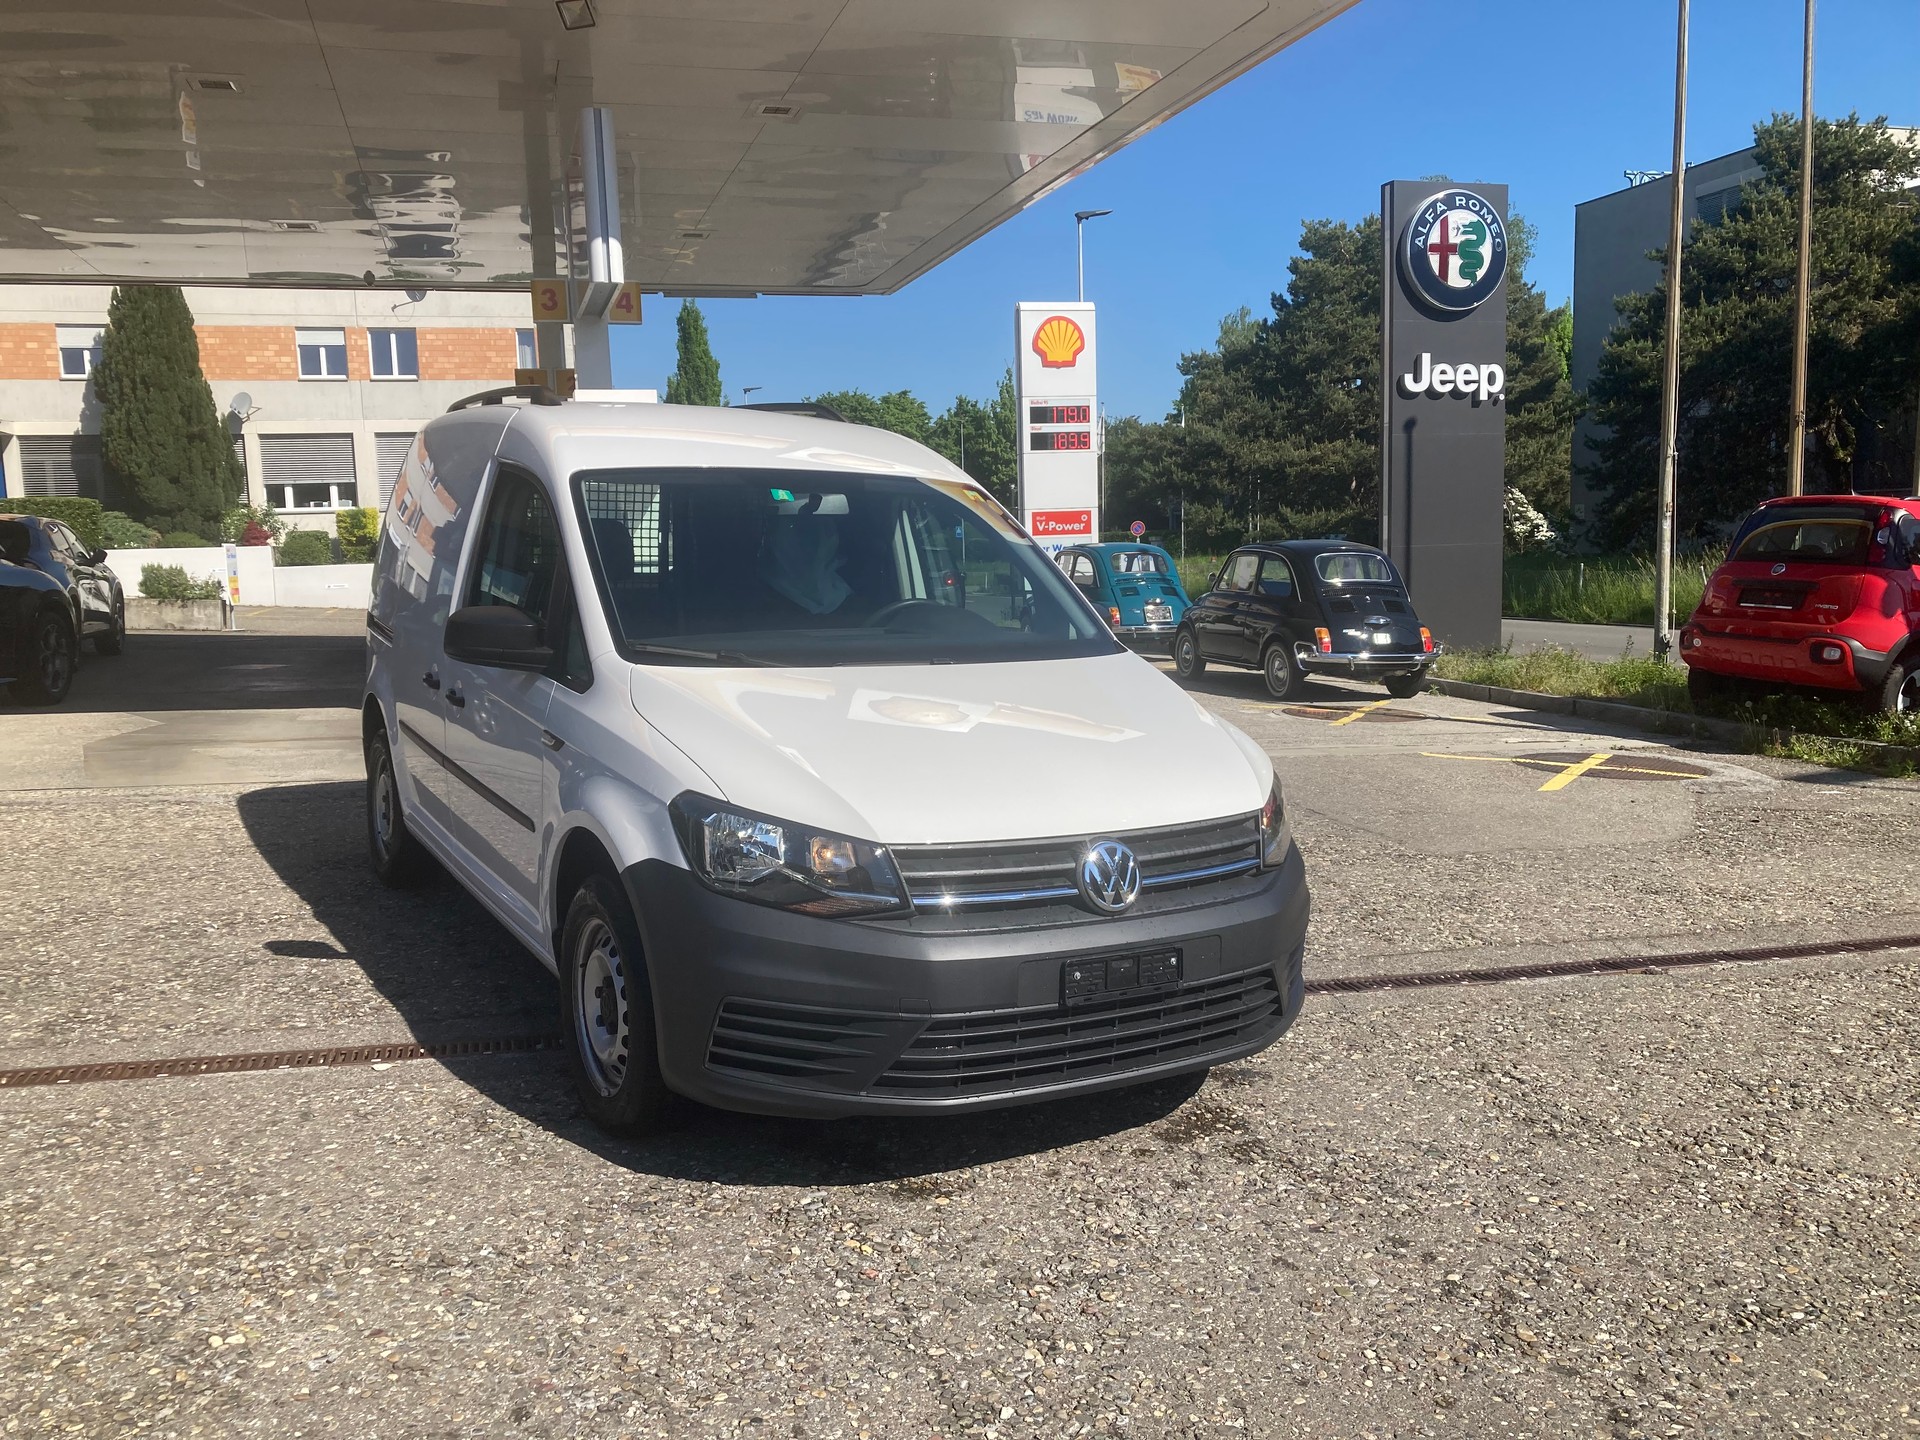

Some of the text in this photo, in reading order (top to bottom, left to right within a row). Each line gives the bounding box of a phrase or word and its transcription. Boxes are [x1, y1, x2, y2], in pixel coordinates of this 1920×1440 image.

[1415, 195, 1503, 252] ALFA ROMEO
[540, 287, 559, 312] 3
[615, 292, 634, 314] 4
[1404, 352, 1505, 401] Jeep
[1052, 406, 1089, 423] 179.0
[1053, 432, 1090, 449] 189.9
[1036, 521, 1086, 532] V-Power
